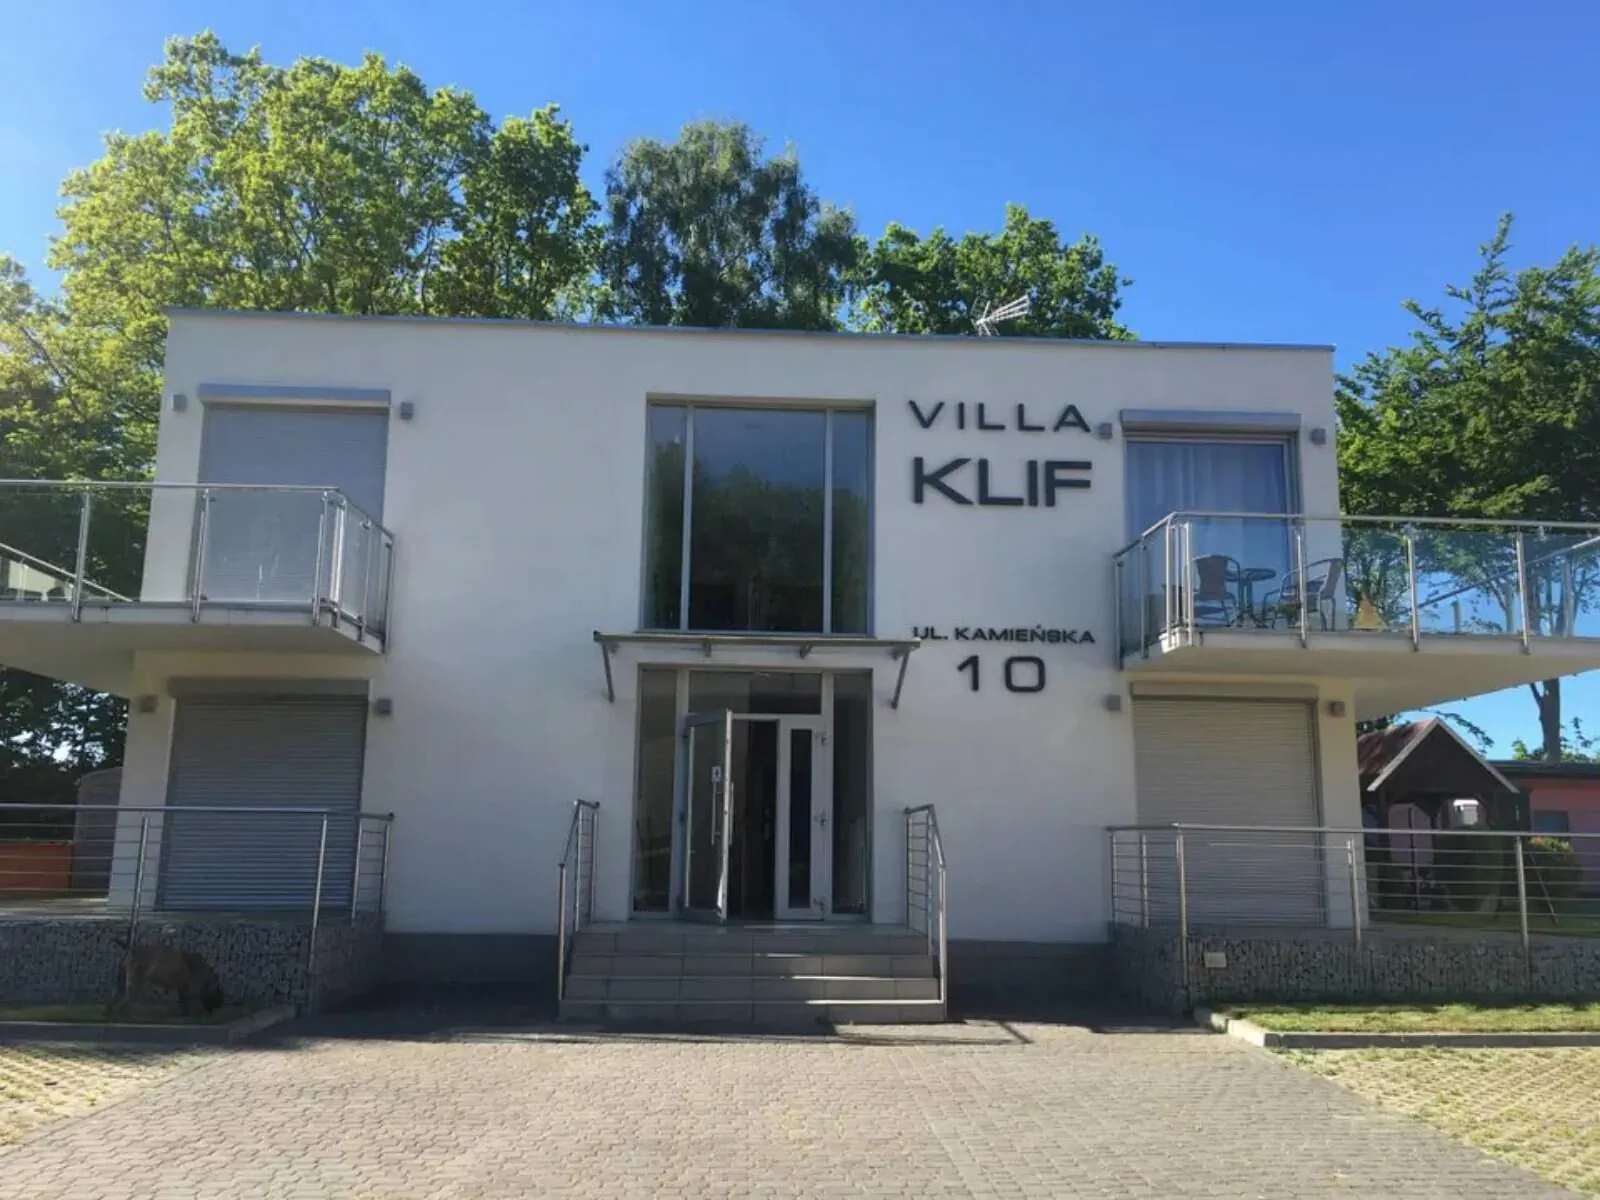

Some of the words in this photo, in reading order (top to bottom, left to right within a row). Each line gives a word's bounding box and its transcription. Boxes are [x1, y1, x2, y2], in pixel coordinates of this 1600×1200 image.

[909, 400, 1091, 433] VILLA
[912, 457, 1092, 507] KLIF
[912, 626, 948, 641] UL.
[955, 624, 1095, 644] KAMIEŃSKA
[957, 655, 1046, 693] 10
